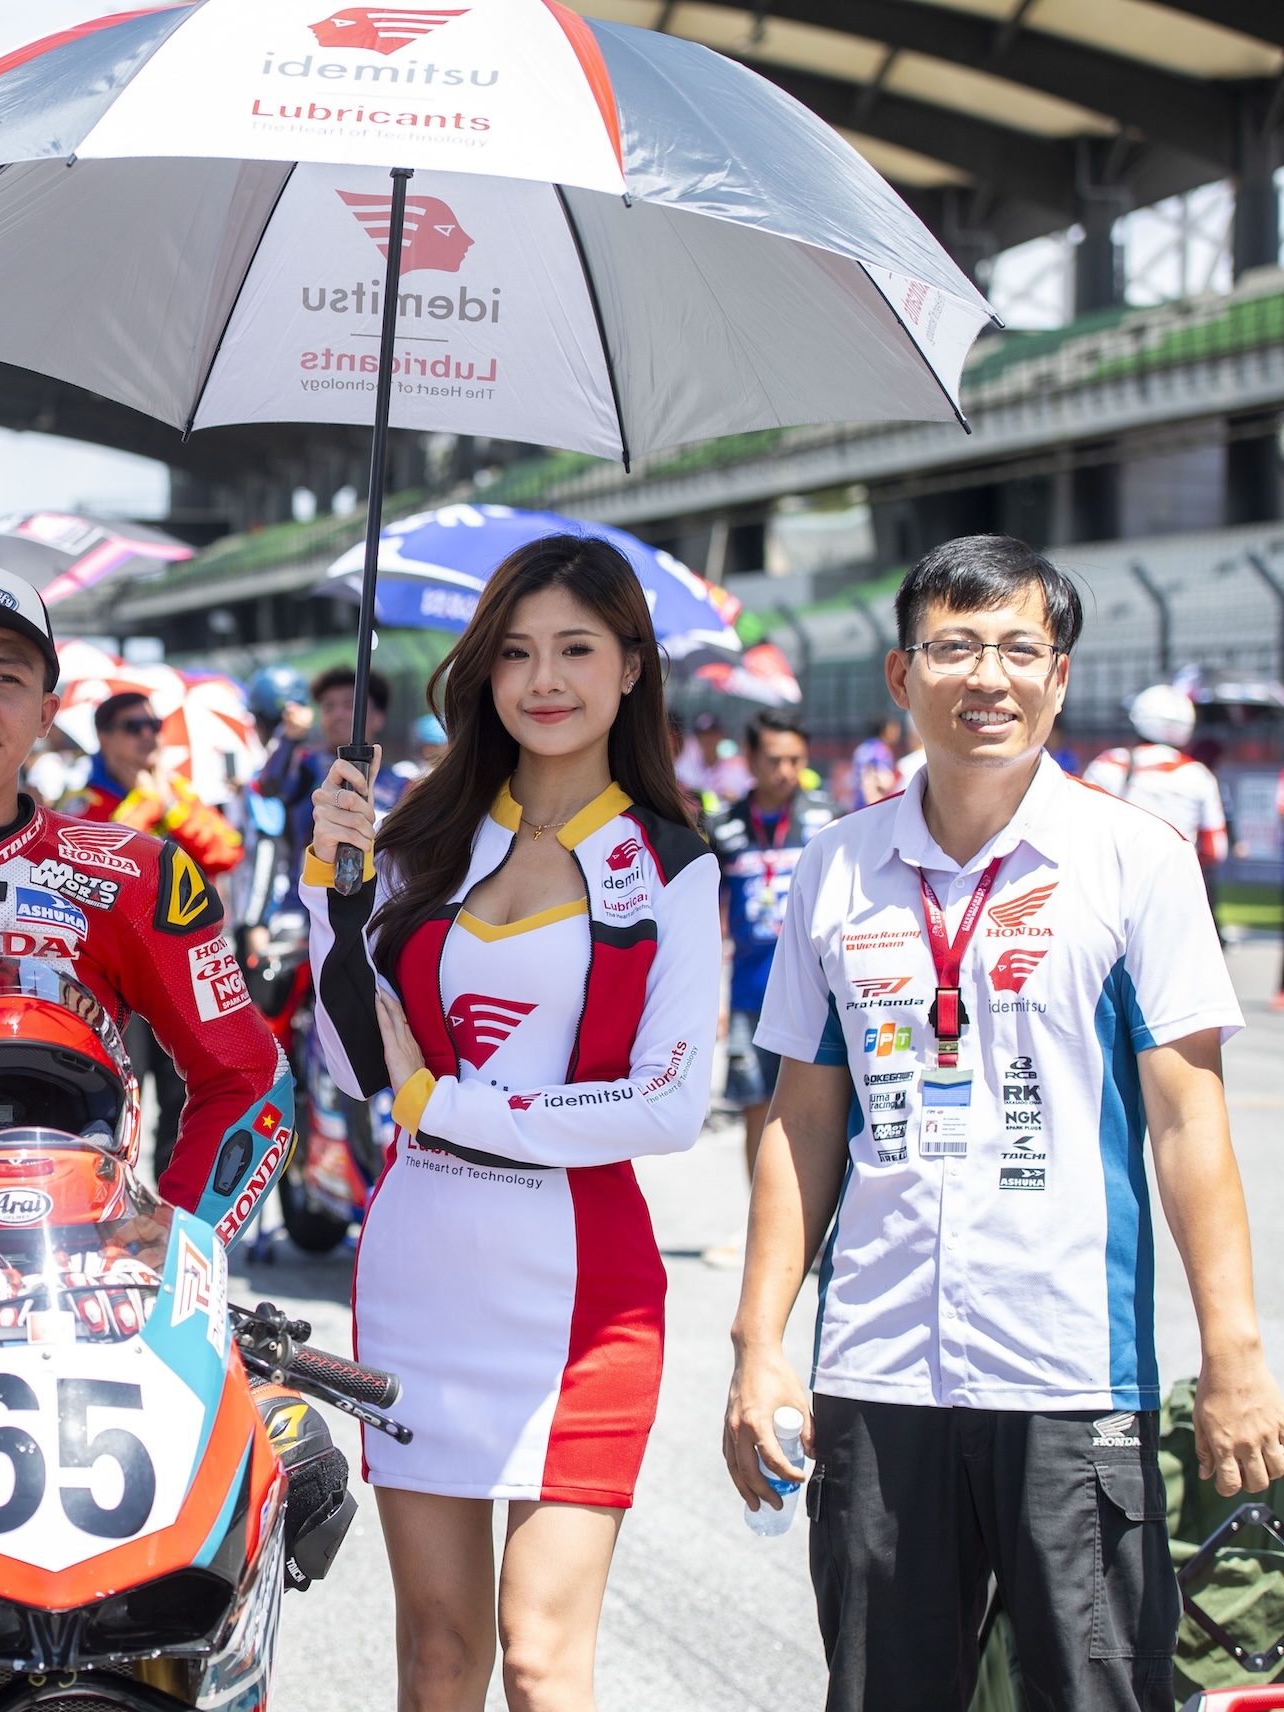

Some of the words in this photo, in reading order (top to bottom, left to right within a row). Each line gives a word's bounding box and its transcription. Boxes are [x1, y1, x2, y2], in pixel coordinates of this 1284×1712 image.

[262, 51, 499, 87] idemitsu
[251, 99, 491, 131] Lubricants
[252, 120, 285, 133] The
[290, 123, 345, 137] Heart
[349, 127, 368, 138] of
[376, 129, 488, 148] Technology
[60, 848, 137, 874] HONDA
[18, 902, 86, 932] ASHUKA
[842, 932, 880, 942] Honda
[880, 930, 921, 941] Racing
[985, 927, 1054, 938] HONDA
[856, 940, 904, 951] Vietnam
[222, 996, 241, 1009] SPARK
[988, 997, 1047, 1013] idemitsu
[637, 1040, 687, 1096] Lubrcnts
[658, 1085, 678, 1098] Heart
[680, 1045, 699, 1081] Thnology
[1005, 1071, 1037, 1079] RCB
[544, 1086, 634, 1107] idemitsu
[871, 1094, 890, 1102] uma
[1003, 1085, 1042, 1101] RK
[871, 1101, 896, 1110] racing
[1005, 1111, 1042, 1124] NGK
[405, 1155, 421, 1168] The
[422, 1159, 449, 1174] Heart
[452, 1166, 464, 1176] of
[467, 1167, 543, 1189] Technology
[216, 1129, 291, 1247] HONDA
[999, 1177, 1045, 1187] ASHUKA
[351, 1407, 381, 1426] RCB
[1092, 1436, 1142, 1448] HONDA
[285, 1557, 306, 1583] TAICHI
